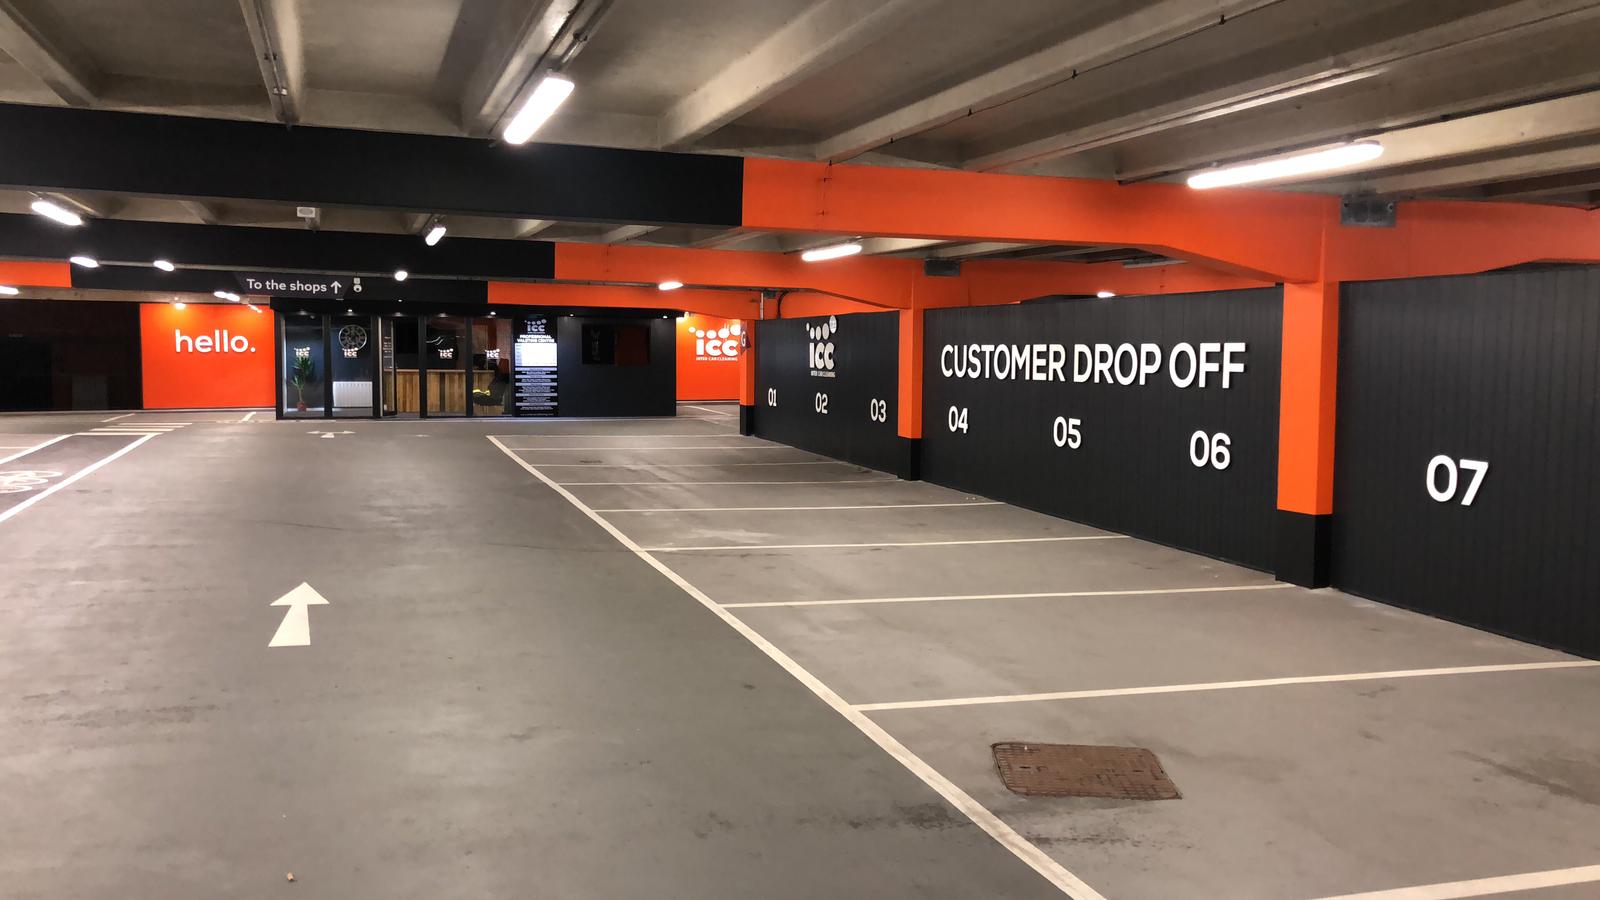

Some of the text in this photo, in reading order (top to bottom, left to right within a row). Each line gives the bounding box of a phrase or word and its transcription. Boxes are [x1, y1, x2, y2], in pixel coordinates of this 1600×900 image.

[246, 278, 327, 294] To the shops
[175, 329, 256, 353] hello.
[940, 341, 1247, 389] CUSTOMER DROP OFF
[767, 387, 778, 407] 01
[815, 392, 829, 415] 02
[870, 398, 887, 423] 03
[948, 405, 969, 434] 04
[1053, 416, 1082, 450] 05
[1189, 430, 1231, 470] 06
[1426, 454, 1489, 506] 07
